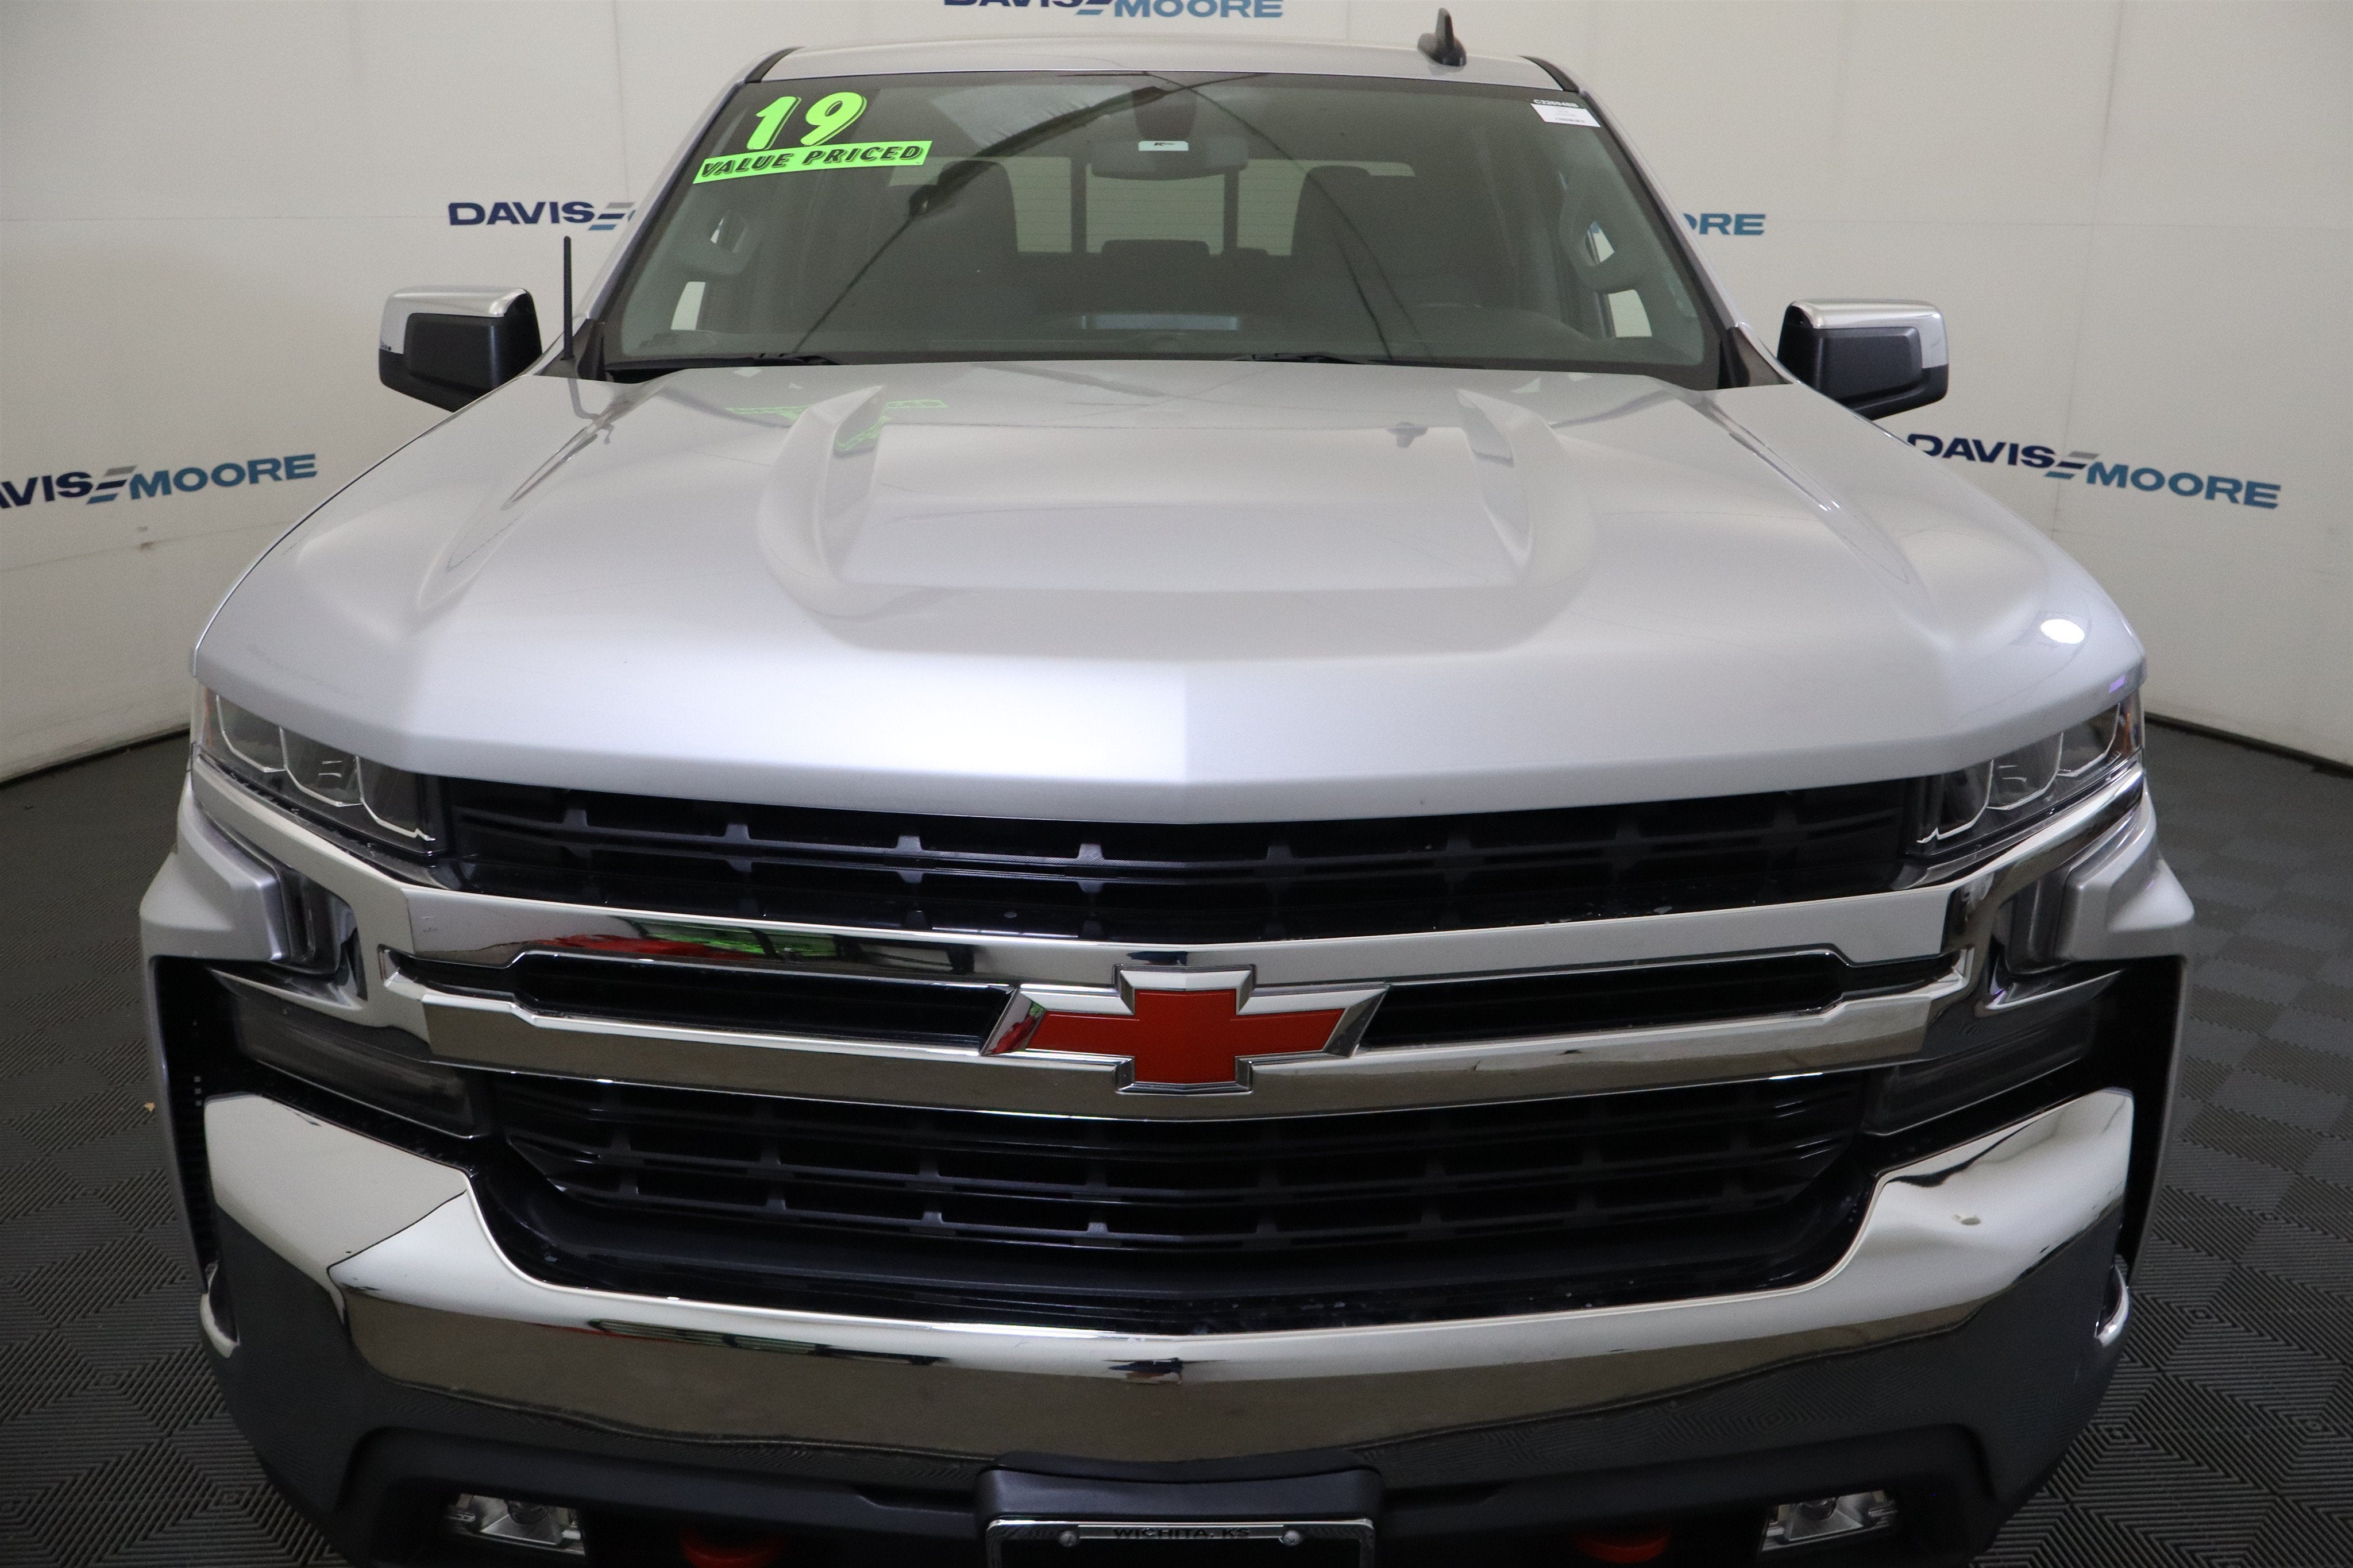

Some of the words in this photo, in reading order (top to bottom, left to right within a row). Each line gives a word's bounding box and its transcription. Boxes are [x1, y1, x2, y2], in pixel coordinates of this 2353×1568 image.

[1114, 0, 1283, 17] MOORE
[747, 92, 867, 150] 19
[701, 153, 792, 176] VALUE
[803, 145, 921, 165] PRICED
[448, 202, 595, 225] DAVIS
[0, 472, 93, 509] VIS
[129, 454, 317, 500] MOORE
[1907, 433, 2056, 469] DAVIS
[2086, 462, 2281, 509] MOORE
[1222, 1528, 1250, 1537] KS
